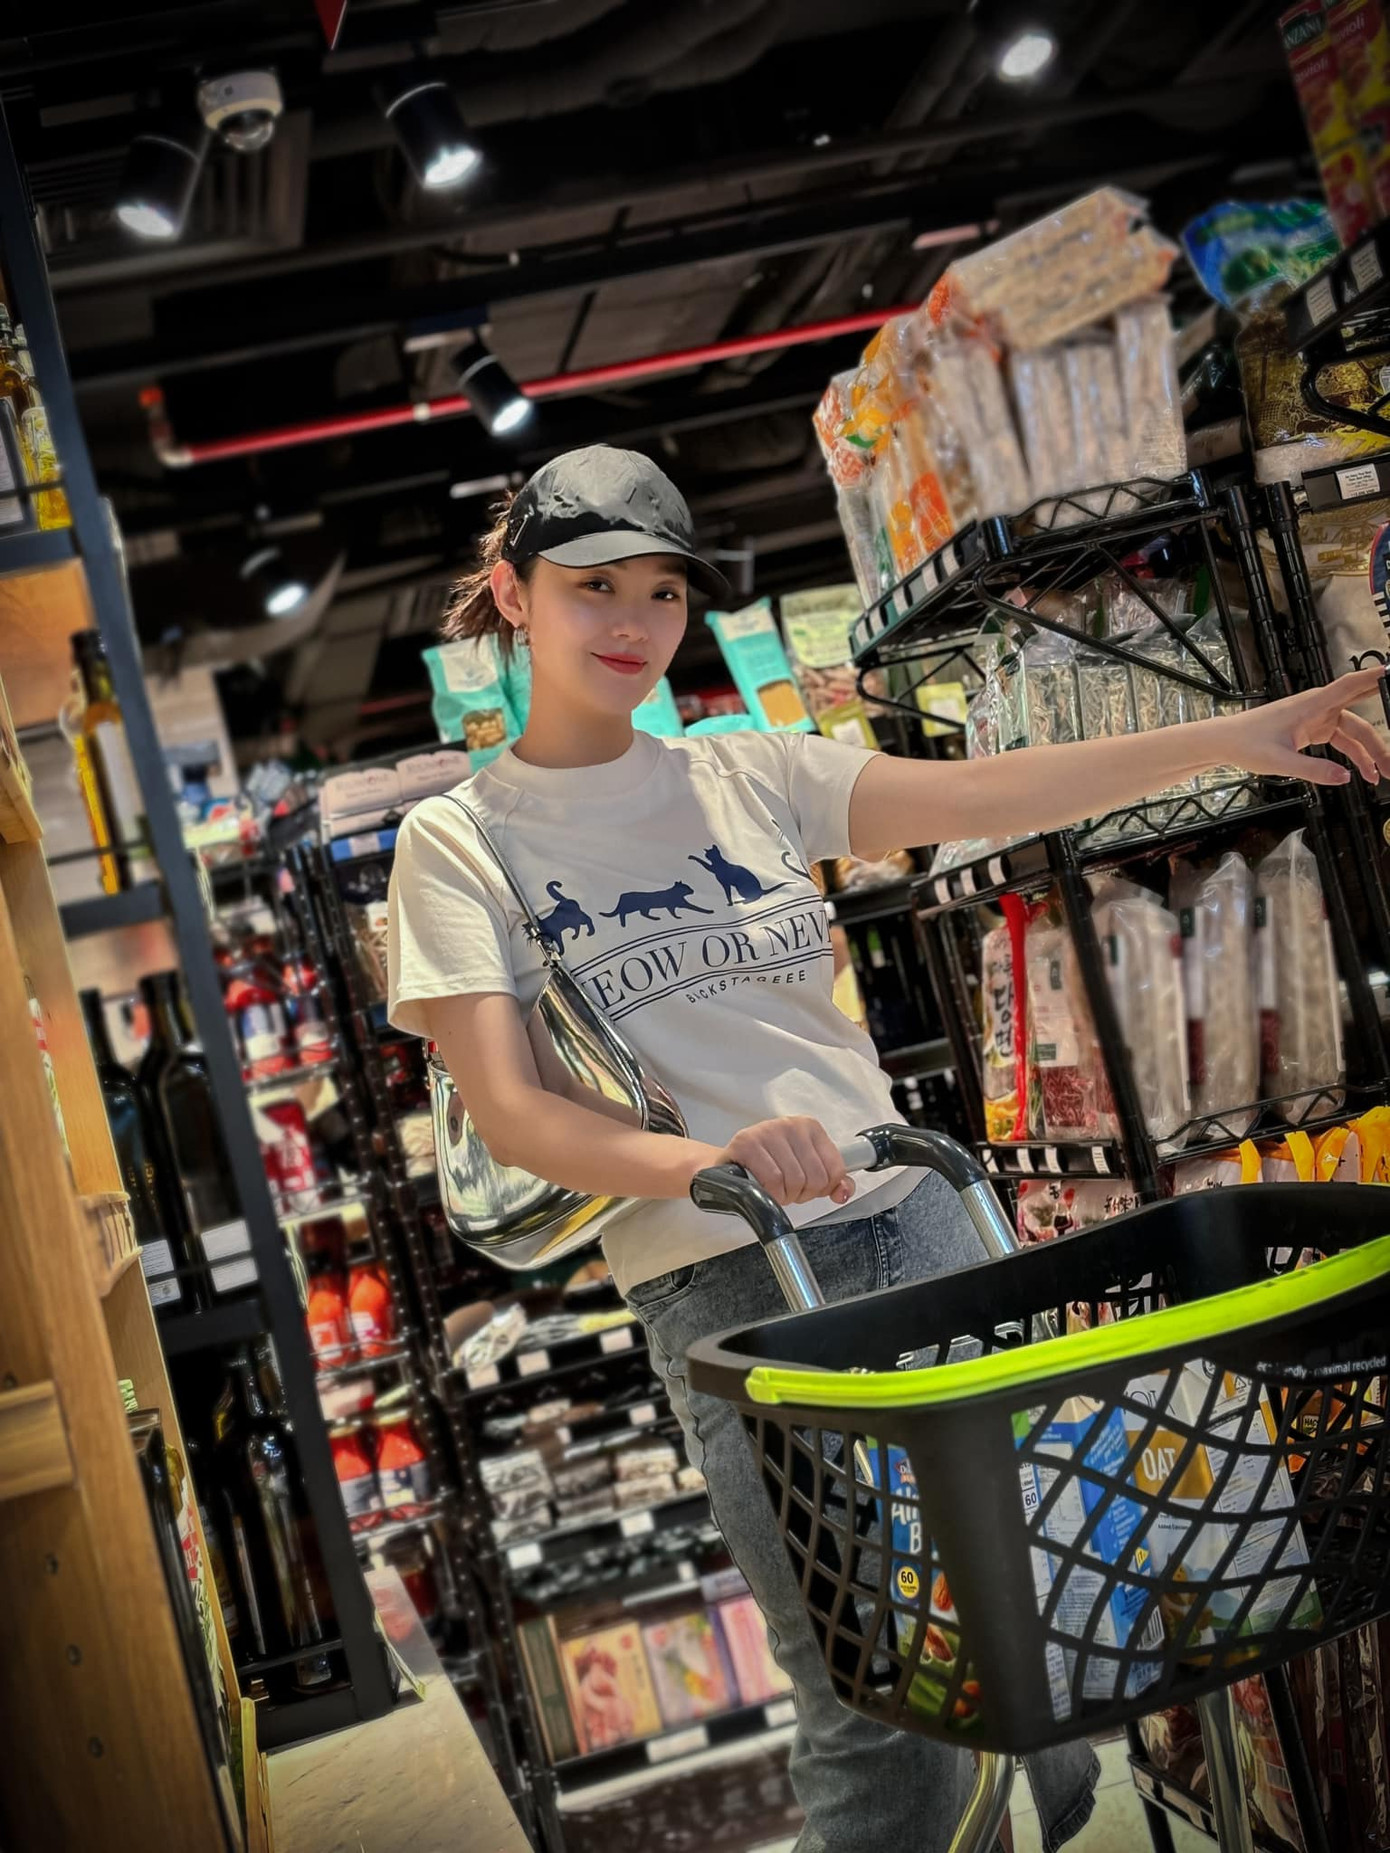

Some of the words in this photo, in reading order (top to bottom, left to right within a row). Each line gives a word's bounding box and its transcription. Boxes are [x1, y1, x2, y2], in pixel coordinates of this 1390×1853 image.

[582, 940, 688, 1009] EOW
[701, 930, 761, 969] OR
[760, 908, 833, 958] NEV
[1351, 1355, 1387, 1373] recycled
[1142, 1446, 1178, 1483] OAT
[1024, 1492, 1037, 1507] 60
[900, 1570, 914, 1585] 60
